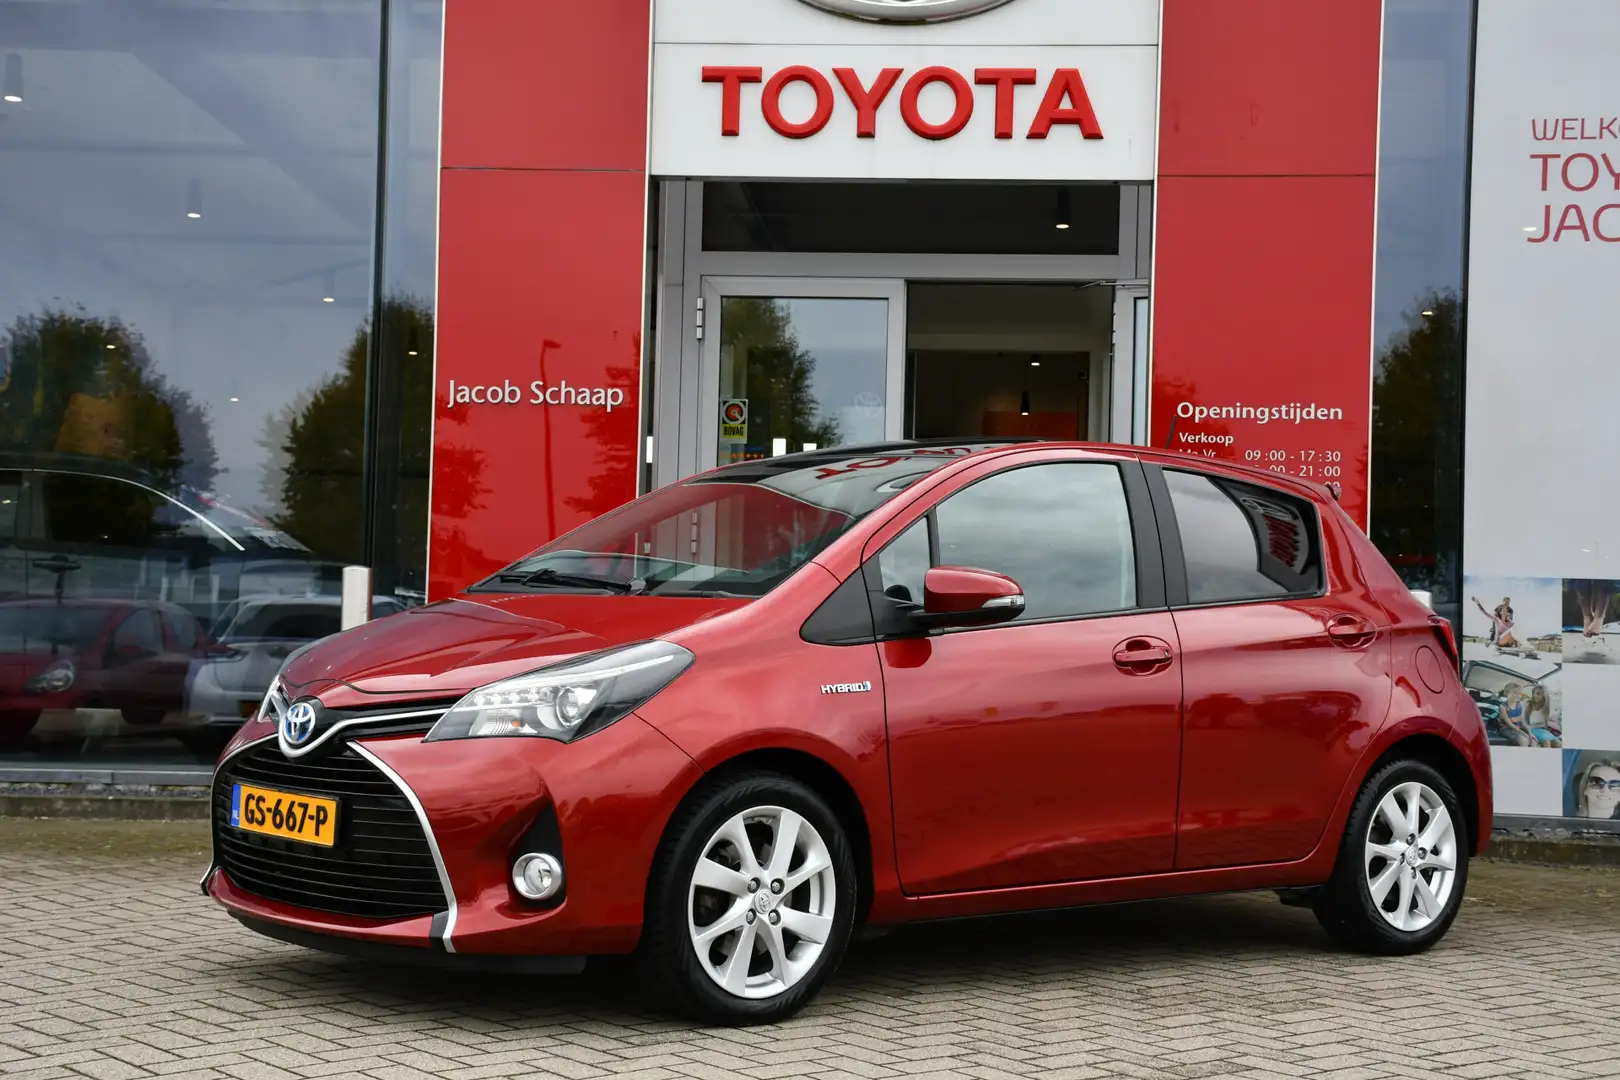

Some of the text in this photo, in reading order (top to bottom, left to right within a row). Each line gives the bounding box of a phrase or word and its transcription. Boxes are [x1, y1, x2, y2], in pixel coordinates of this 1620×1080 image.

[702, 65, 1104, 140] TOYOTA
[1531, 117, 1620, 141] WELK
[1529, 152, 1620, 192] TOY
[1526, 203, 1620, 243] JAC
[447, 379, 624, 412] Jacob Schaap
[1176, 401, 1343, 424] Openingstijden
[723, 426, 744, 436] BOVAG
[1178, 432, 1234, 446] Verkoop
[820, 682, 866, 694] HYBRID
[244, 793, 328, 837] GS-667-P
